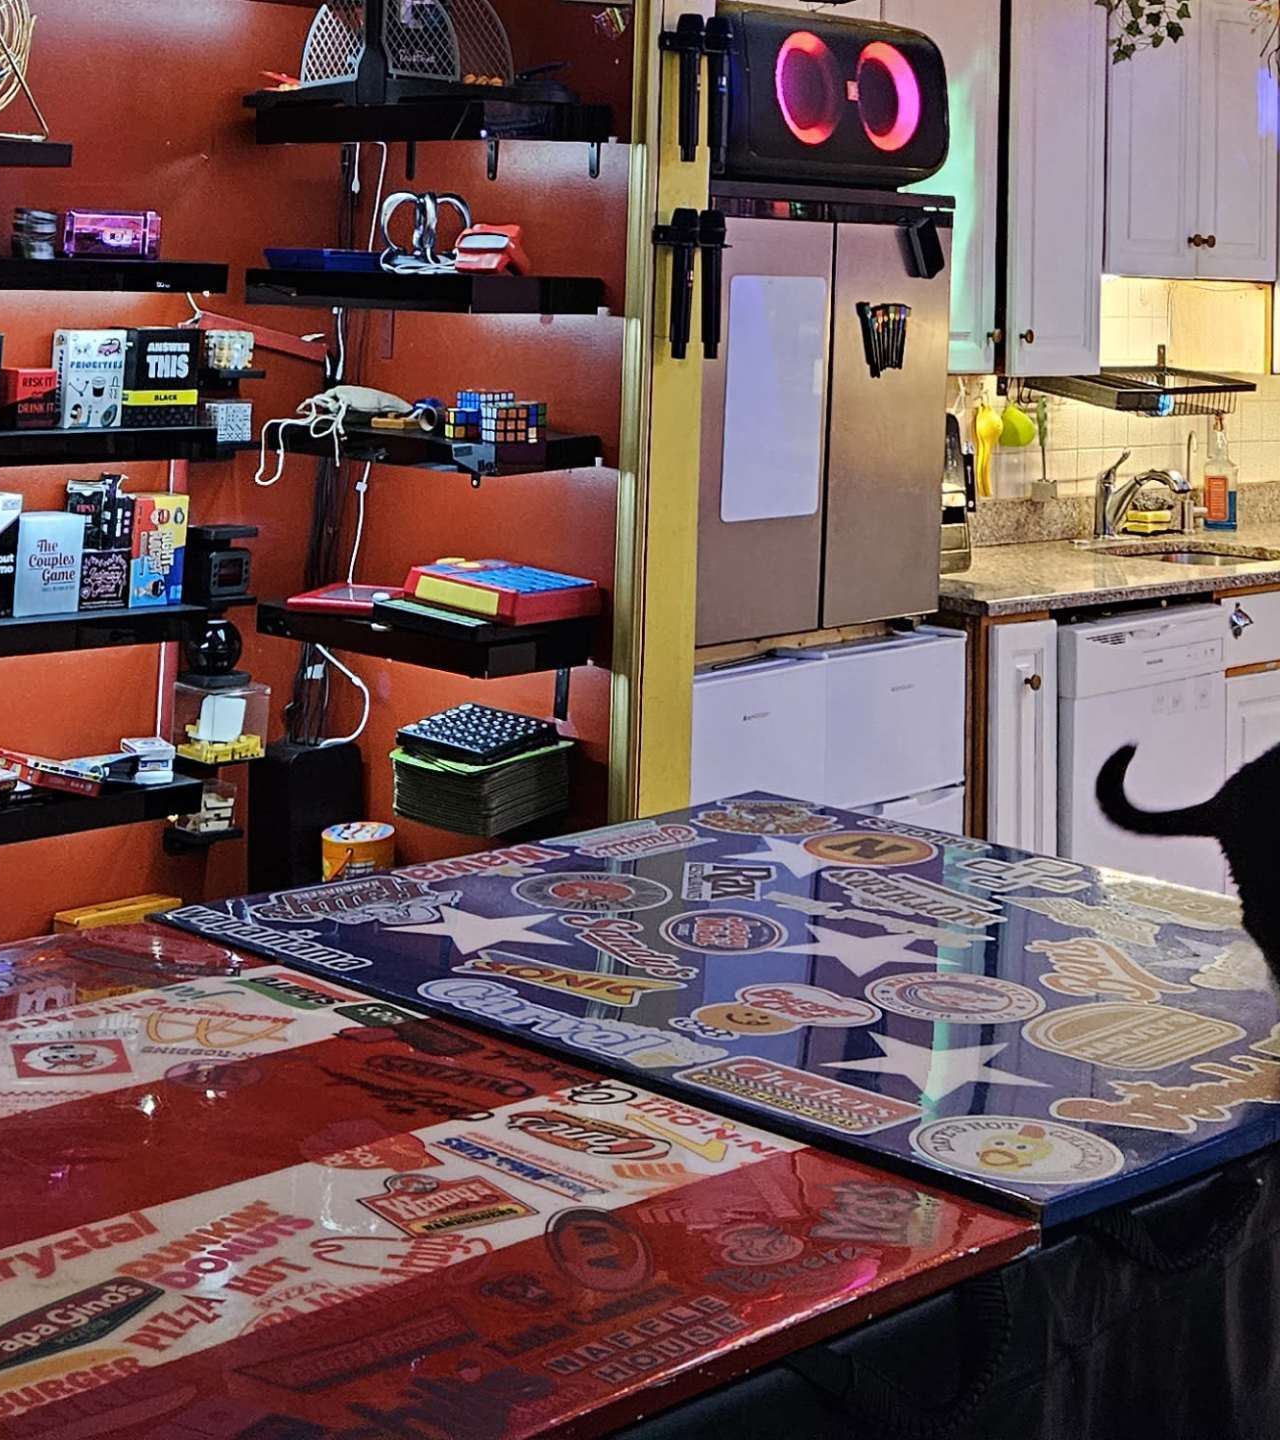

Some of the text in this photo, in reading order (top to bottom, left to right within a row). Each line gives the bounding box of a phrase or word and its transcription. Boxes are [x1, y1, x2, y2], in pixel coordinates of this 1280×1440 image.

[146, 342, 190, 353] ANSWER
[22, 376, 54, 387] RISK IT
[146, 354, 190, 379] THIS
[18, 403, 46, 413] DRINK
[154, 394, 178, 402] BLACK
[28, 553, 75, 568] Couples
[36, 539, 58, 553] The
[41, 569, 76, 586] Game
[402, 845, 558, 881] Wawa
[705, 865, 774, 900] Rax
[176, 905, 370, 971] wagamama
[468, 958, 648, 1003] SONIC
[0, 997, 167, 1032] OUTBACK
[155, 1005, 297, 1026] McDonald's
[427, 980, 672, 1058] Carvel
[728, 1062, 898, 1119] Checkers
[440, 1136, 495, 1160] SUBS
[373, 1183, 488, 1221] Wendy's
[117, 1199, 282, 1280] DUNKIN'
[154, 1213, 317, 1290] DONUTS
[56, 1280, 149, 1332] Gino's
[123, 1294, 227, 1352] PIZZA
[224, 1256, 312, 1298] HUT
[546, 1296, 728, 1373] WAFFLE
[595, 1313, 748, 1384] HOUSE
